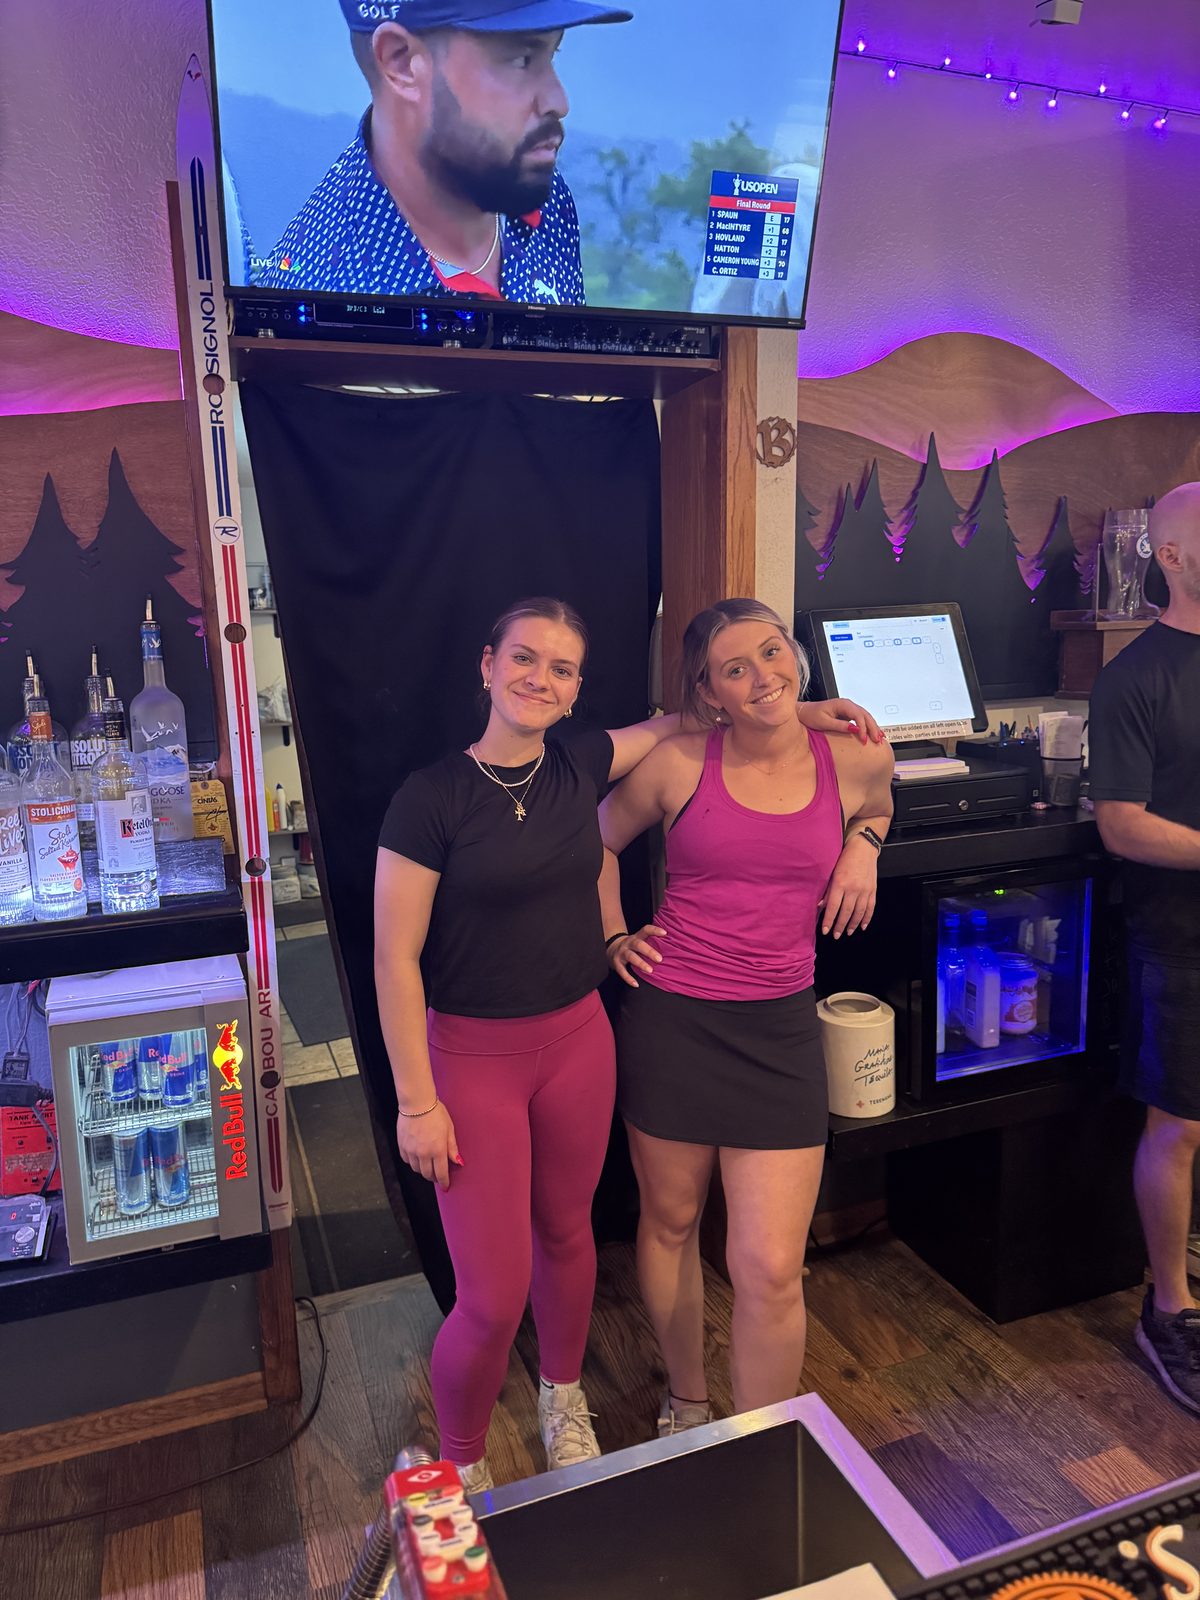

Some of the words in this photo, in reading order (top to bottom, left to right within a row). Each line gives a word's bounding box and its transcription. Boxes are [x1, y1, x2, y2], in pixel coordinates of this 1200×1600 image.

[358, 3, 400, 19] GOLF
[751, 201, 771, 210] Round
[717, 210, 739, 219] SPAUN
[784, 216, 790, 224] 17
[716, 222, 751, 231] MacINTYRE
[715, 233, 745, 243] HOVLAND
[714, 245, 740, 254] HATTON
[251, 258, 273, 268] LIVE
[713, 256, 740, 265] CAMERON
[740, 258, 760, 266] YOUNG
[712, 267, 719, 275] C.
[719, 267, 738, 275] ORTIZ
[200, 281, 225, 427] ROSIGNOL
[907, 724, 922, 732] added
[914, 731, 931, 740] parties
[150, 786, 185, 797] GOOSE
[167, 1052, 187, 1065] Bull
[260, 1027, 278, 1118] CABOU
[219, 1093, 245, 1137] Bull
[222, 1139, 248, 1181] Red
